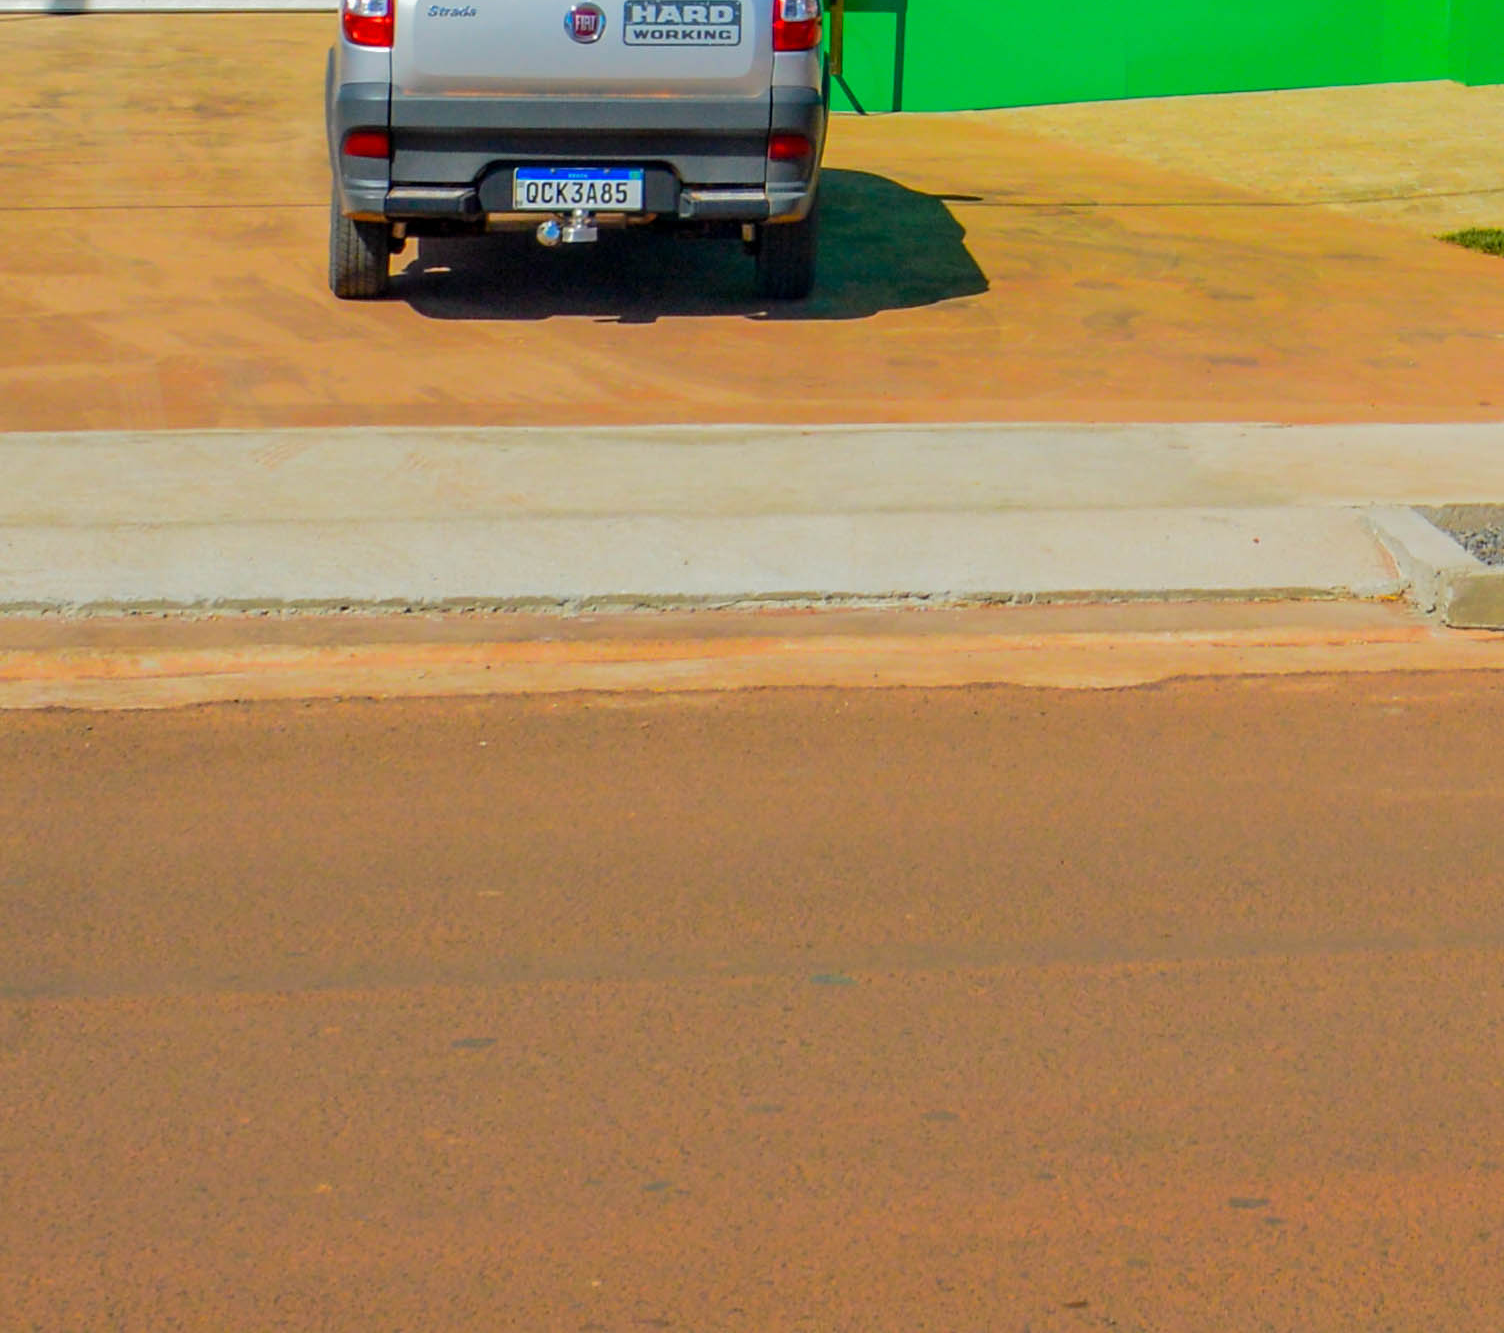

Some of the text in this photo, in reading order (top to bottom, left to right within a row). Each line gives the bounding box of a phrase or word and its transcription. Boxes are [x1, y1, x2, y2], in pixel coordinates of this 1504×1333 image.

[427, 4, 477, 17] Strada
[632, 4, 735, 24] HARD
[575, 14, 597, 32] FIAT
[633, 28, 732, 41] WORKING
[526, 181, 629, 204] QCK3A85
